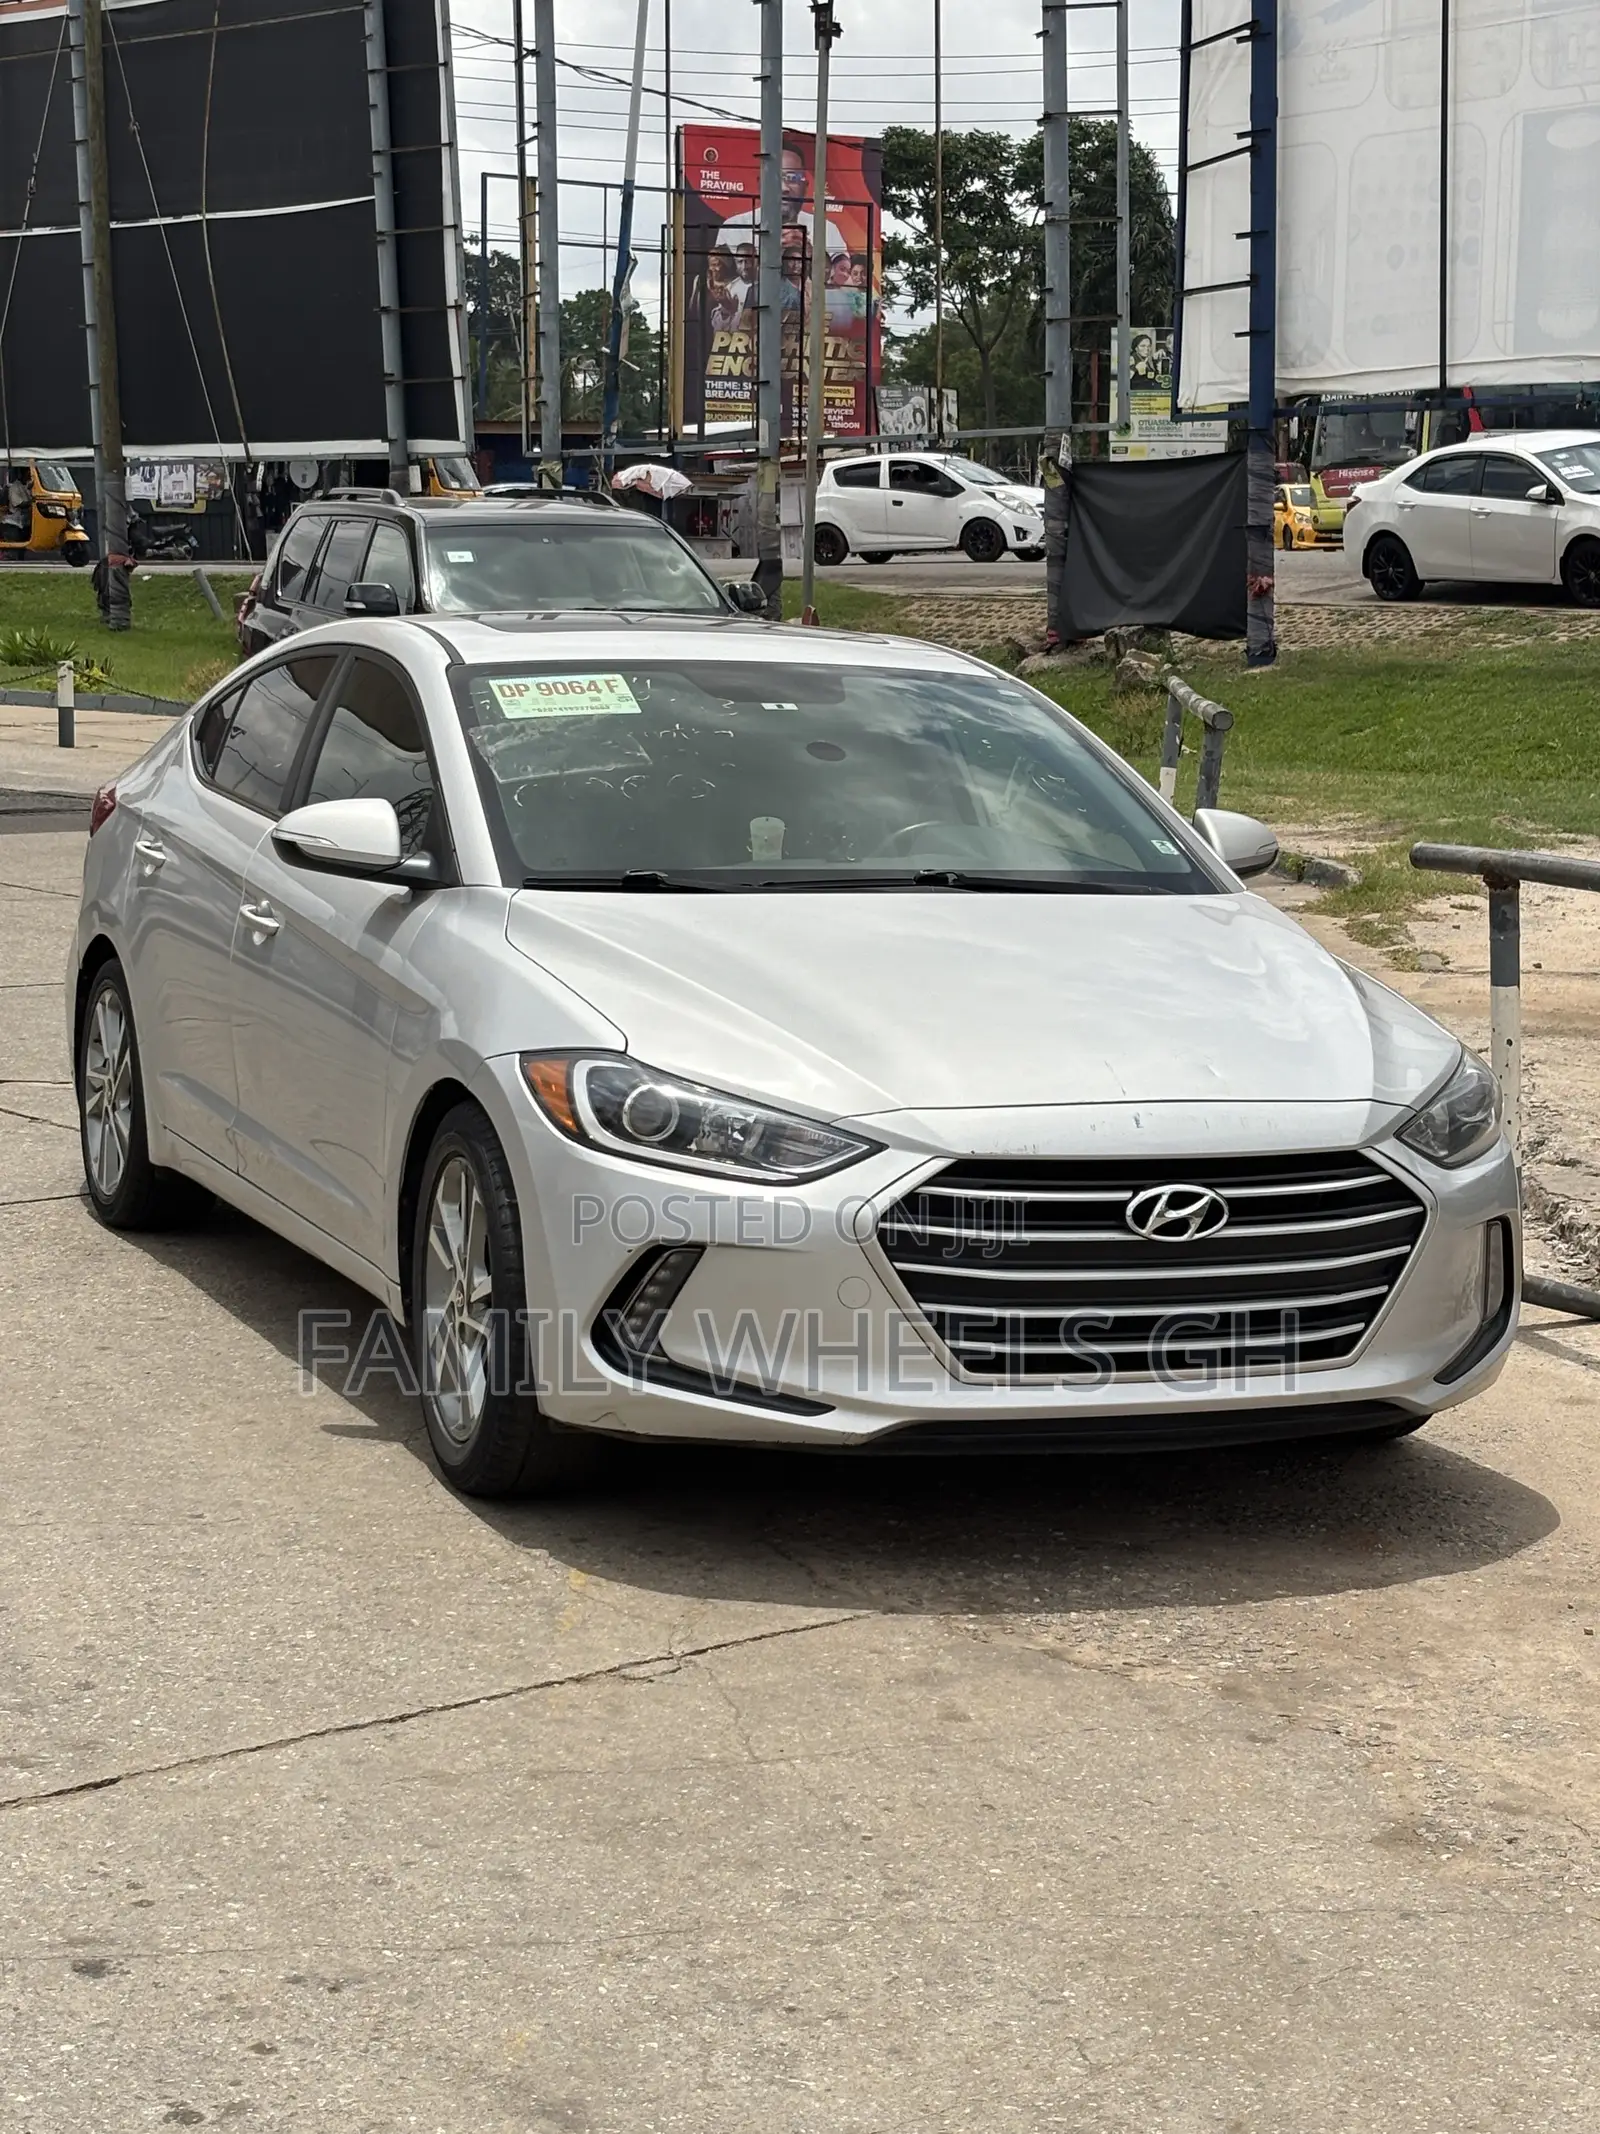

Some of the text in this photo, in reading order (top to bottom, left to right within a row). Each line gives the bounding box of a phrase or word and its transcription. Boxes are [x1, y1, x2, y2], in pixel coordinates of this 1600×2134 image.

[700, 170, 720, 180] THE
[700, 179, 744, 191] PRAYING
[705, 380, 741, 390] THEME:
[704, 389, 751, 400] BREAKER
[1338, 468, 1375, 478] Hisense
[497, 679, 620, 698] DP 9064 F
